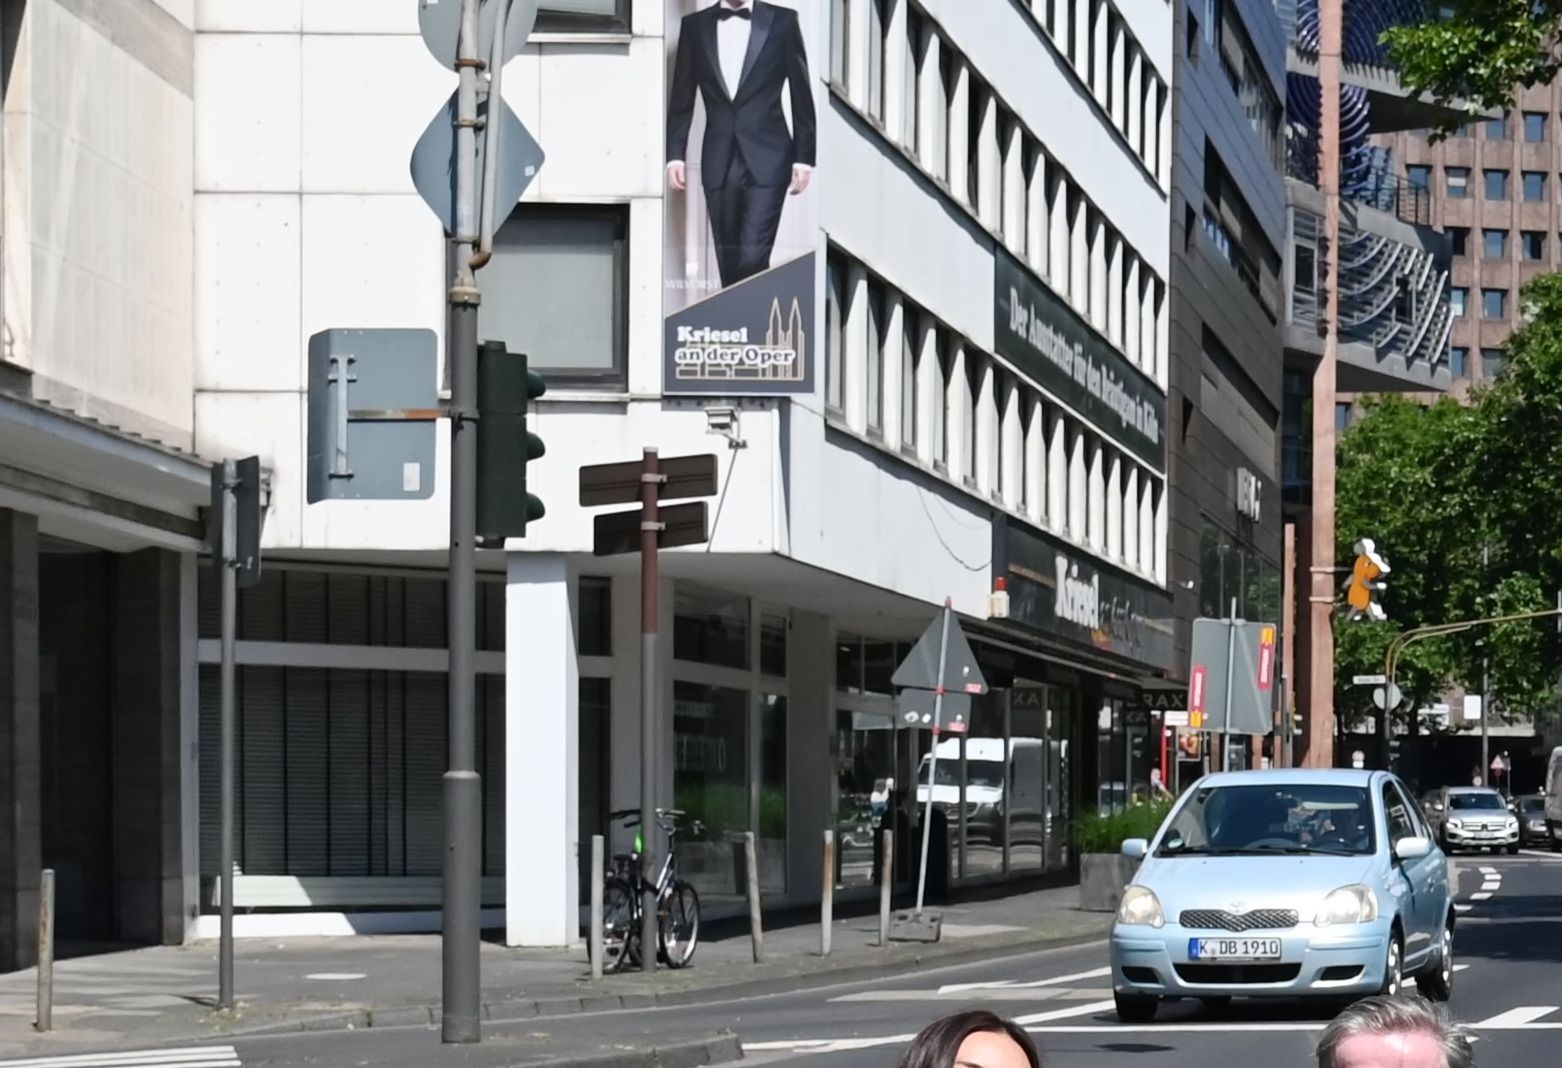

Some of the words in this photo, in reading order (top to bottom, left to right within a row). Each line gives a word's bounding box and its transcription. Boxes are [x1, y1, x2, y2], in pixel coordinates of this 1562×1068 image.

[677, 325, 748, 343] Kriesel
[677, 349, 701, 361] an
[706, 347, 740, 361] der
[744, 347, 794, 366] Oper
[1010, 286, 1028, 339] Der
[1028, 303, 1073, 377] Ausstatter
[1073, 342, 1087, 387] für
[1087, 354, 1101, 400] den
[1101, 363, 1136, 429] Bräutigam
[1143, 401, 1159, 444] Köln
[1055, 555, 1099, 630] Kriesel
[1200, 941, 1208, 954] K
[1219, 940, 1238, 955] DB
[1241, 940, 1279, 955] 1910
